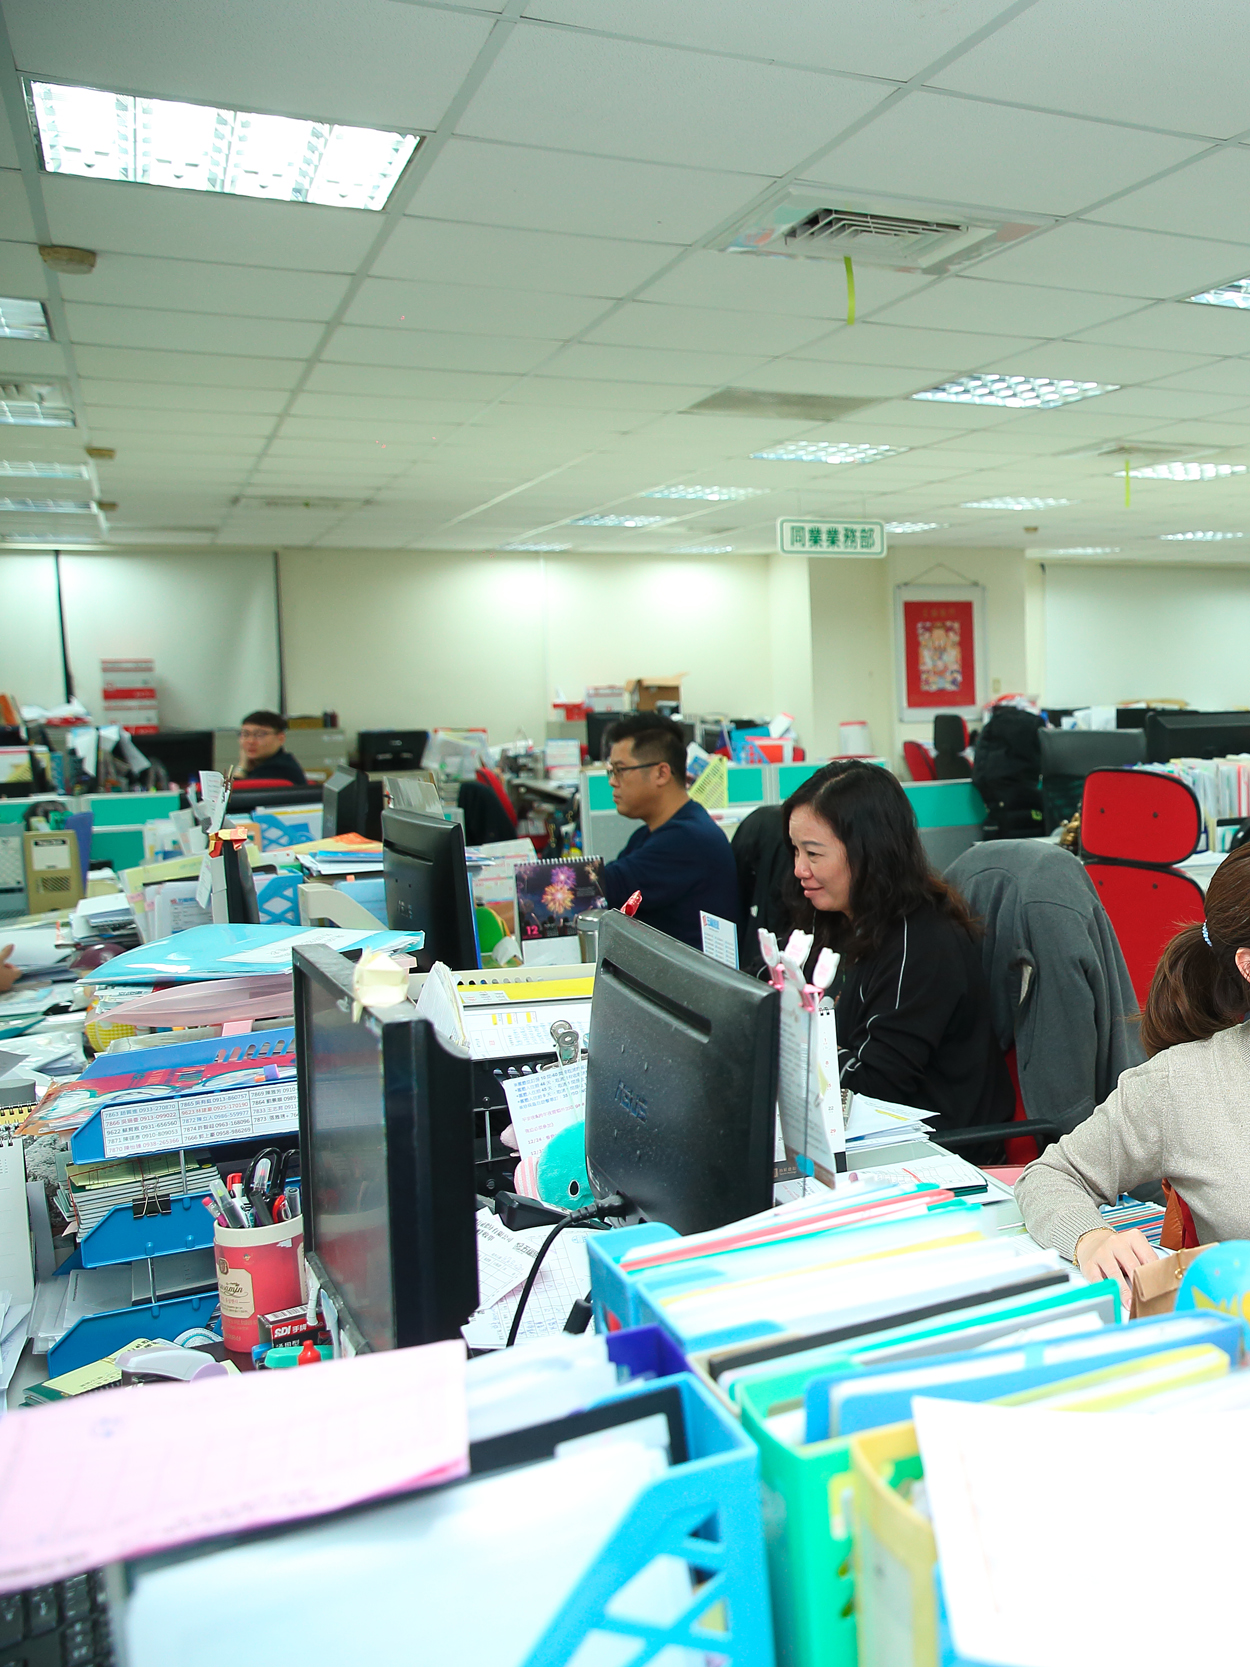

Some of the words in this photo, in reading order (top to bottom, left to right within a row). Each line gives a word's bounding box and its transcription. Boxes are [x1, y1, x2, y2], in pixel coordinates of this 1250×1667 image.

[790, 526, 875, 549] 同業業務部
[526, 925, 539, 935] 12
[614, 1080, 648, 1124] ASUS
[274, 1325, 291, 1338] SDI
